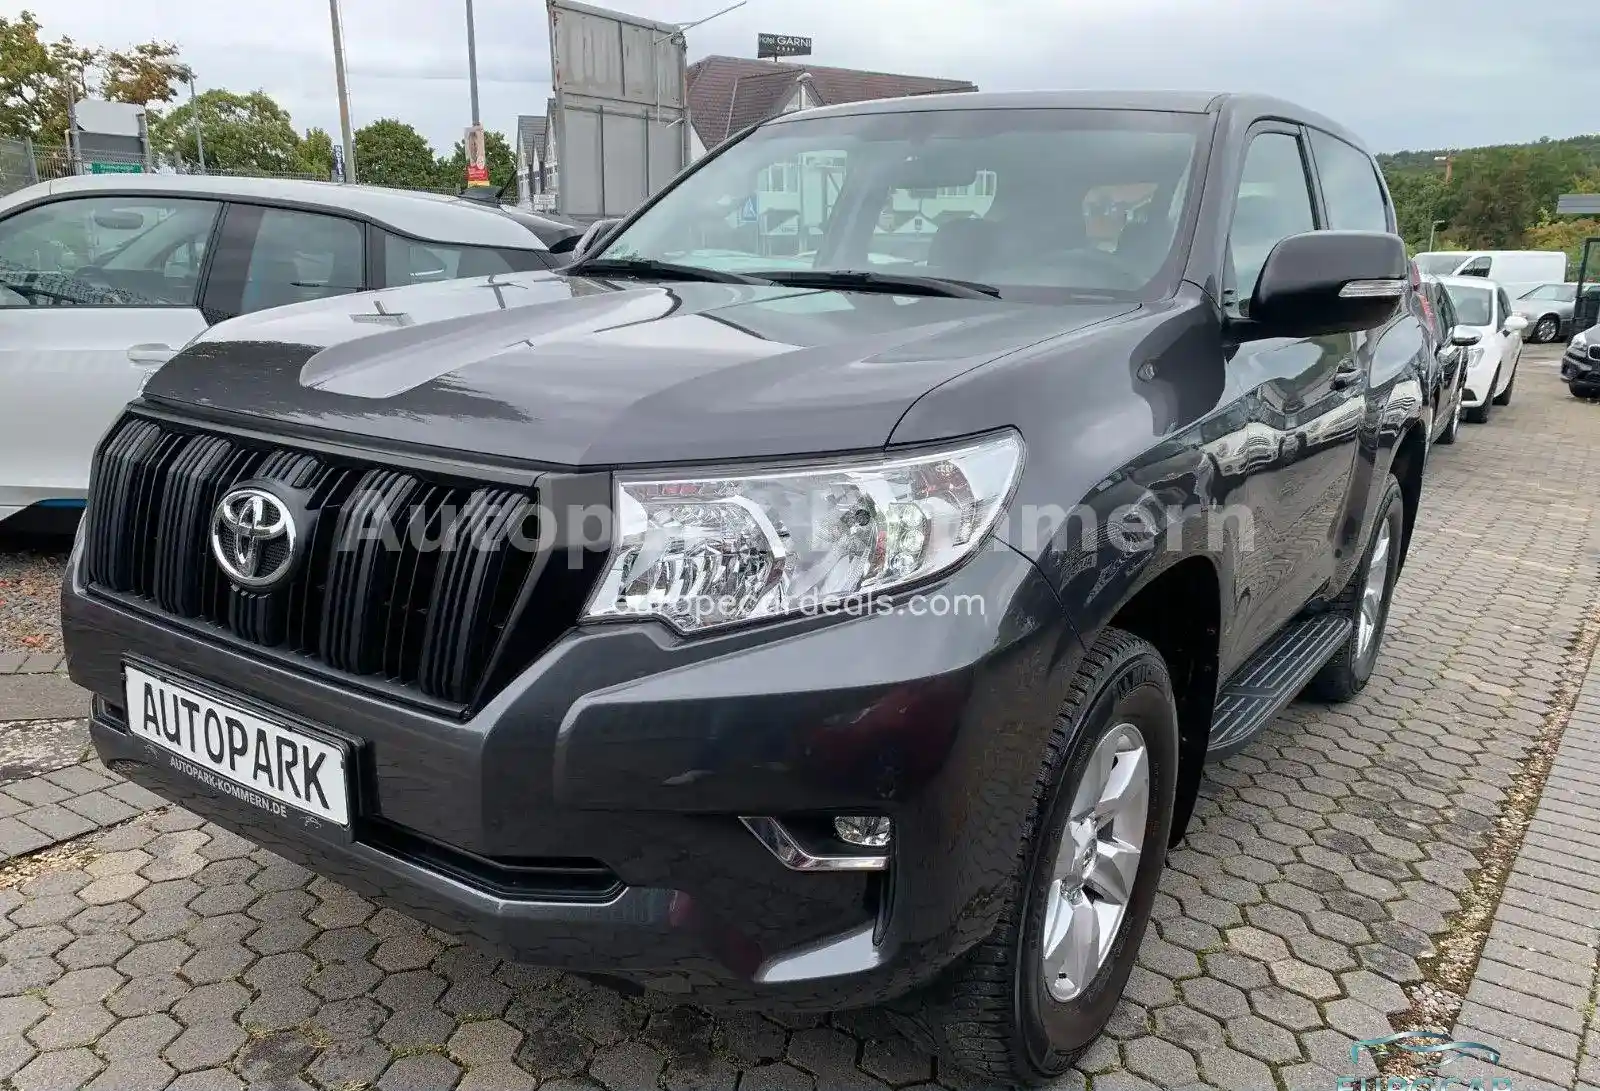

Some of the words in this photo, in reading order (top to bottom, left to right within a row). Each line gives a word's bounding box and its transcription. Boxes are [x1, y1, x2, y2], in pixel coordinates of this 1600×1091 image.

[777, 36, 812, 48] GARNI
[143, 682, 330, 810] AUTOPARK
[170, 756, 288, 818] AUTOPARK-KOMMERN.DE
